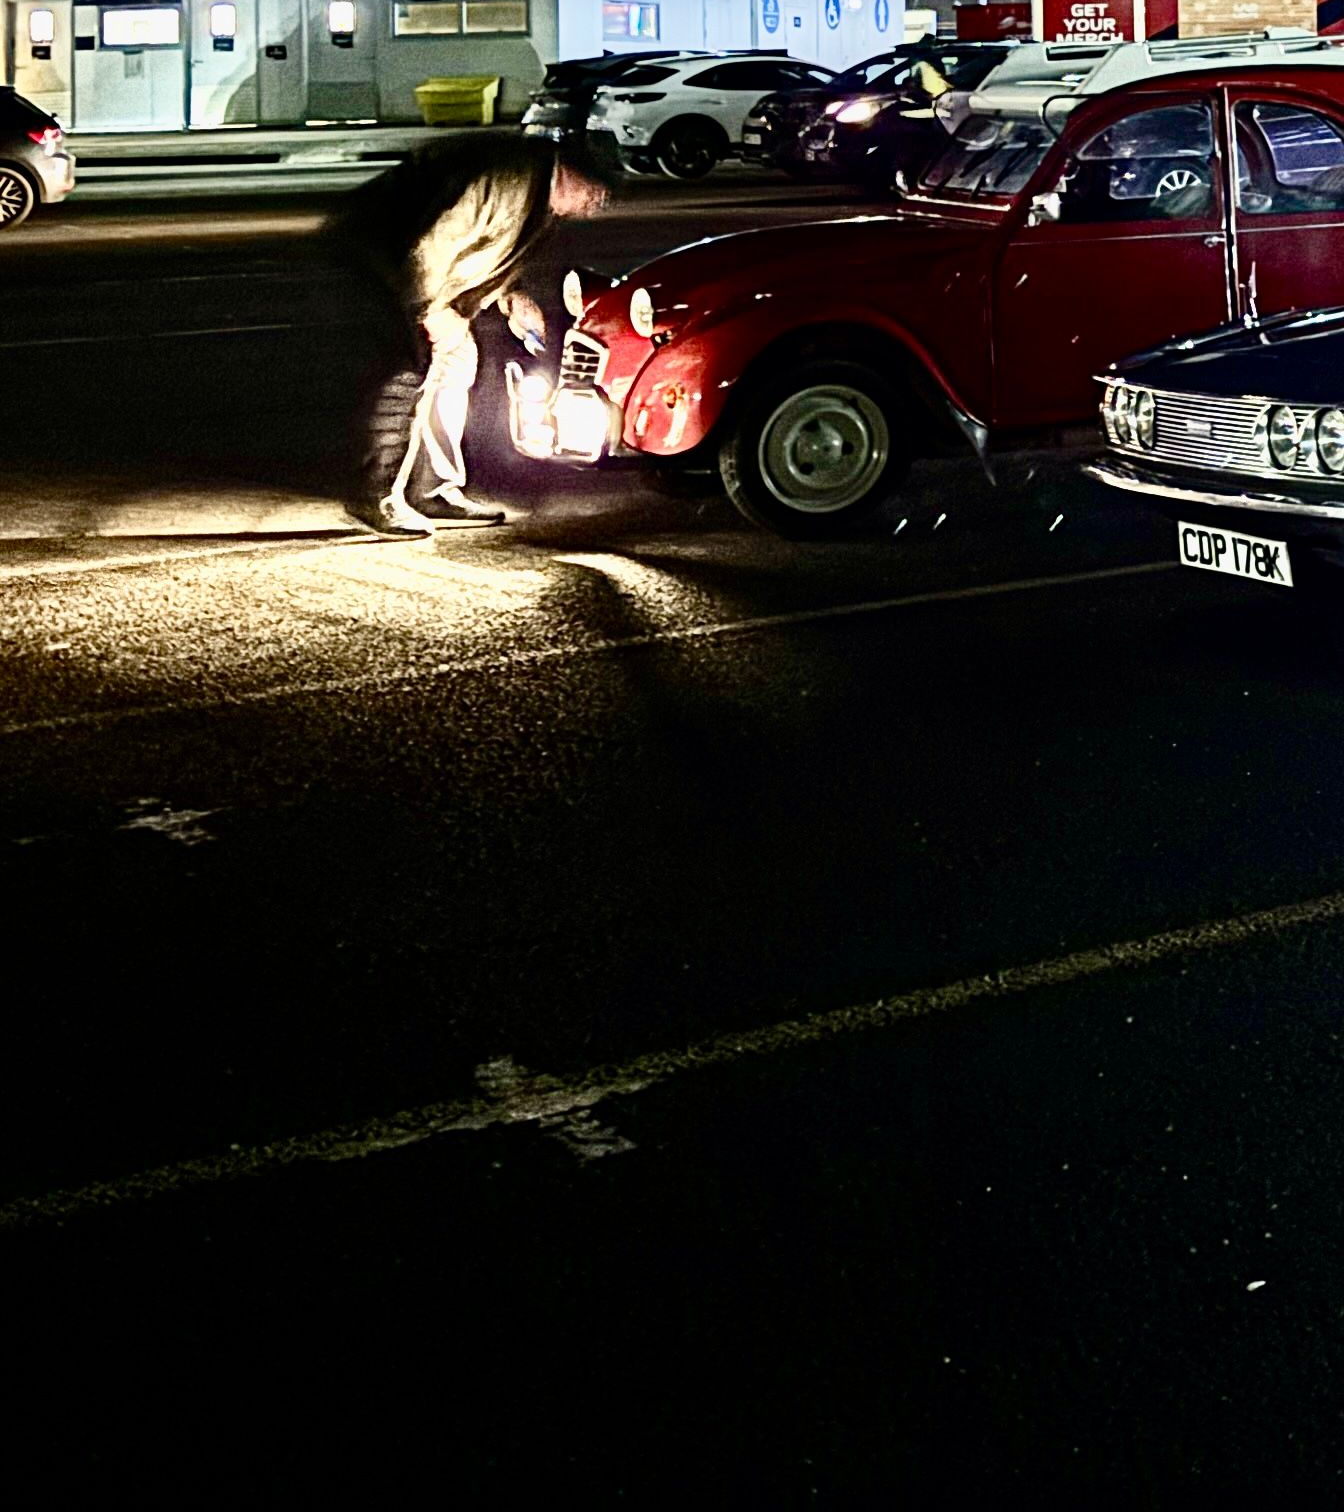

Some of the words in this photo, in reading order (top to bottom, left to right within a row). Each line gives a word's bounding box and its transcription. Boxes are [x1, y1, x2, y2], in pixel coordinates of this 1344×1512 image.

[1071, 3, 1109, 17] GET
[1063, 18, 1116, 32] YOUR
[1182, 528, 1226, 568] CDP
[1232, 537, 1285, 581] 178K
